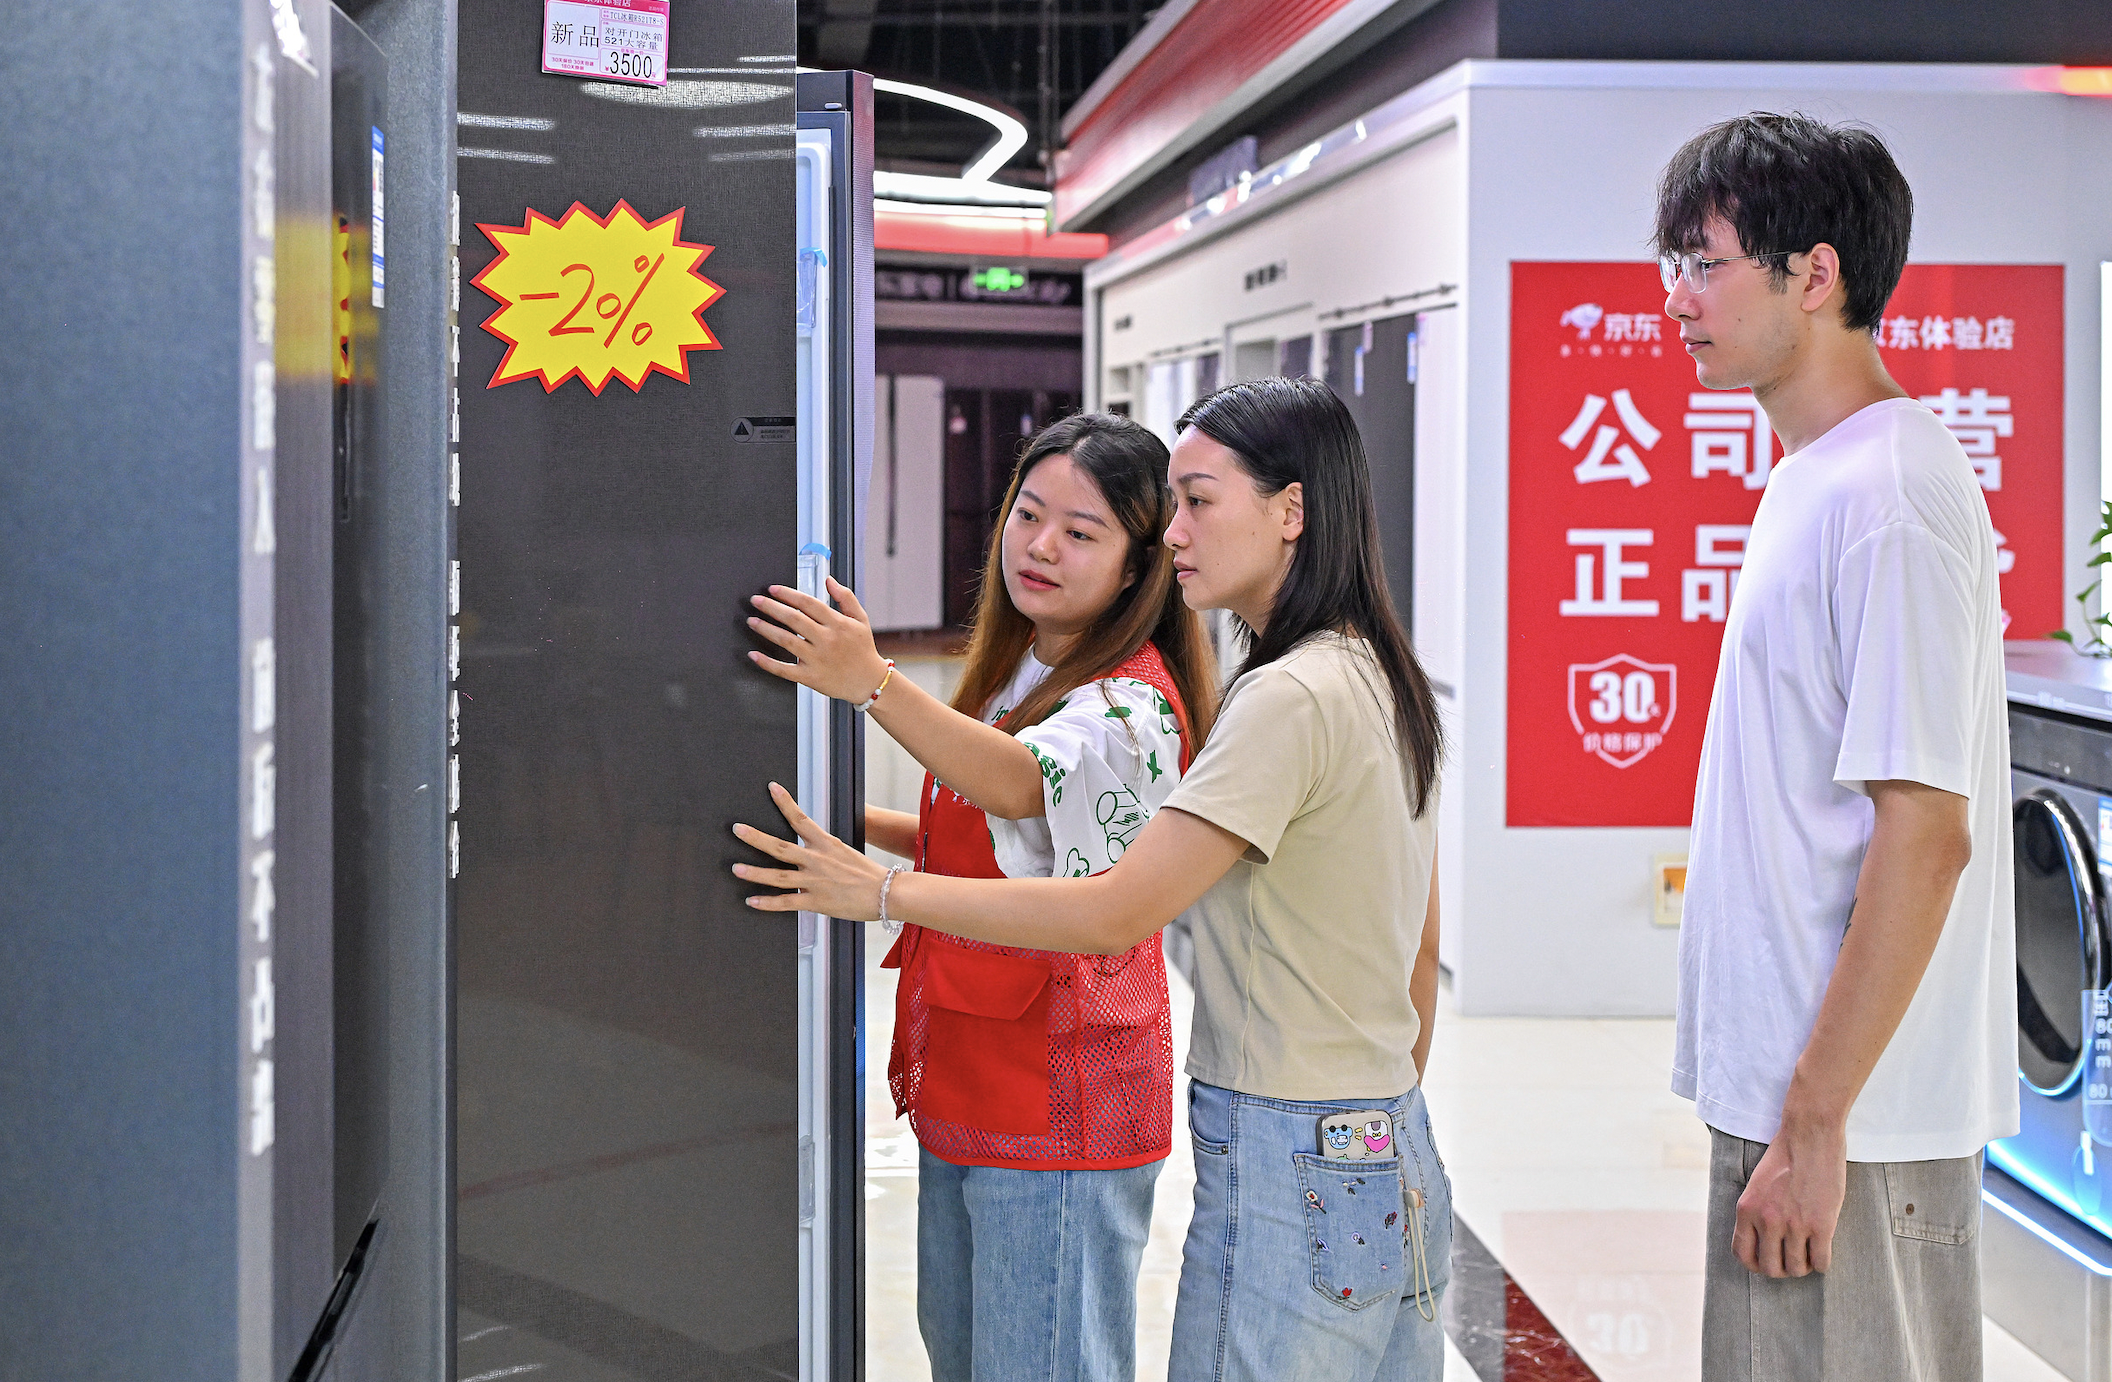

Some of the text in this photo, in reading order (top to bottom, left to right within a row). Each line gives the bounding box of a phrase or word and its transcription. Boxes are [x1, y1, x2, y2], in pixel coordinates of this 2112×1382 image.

[604, 27, 663, 42] 对开门冰箱
[604, 36, 658, 50] 521大容量
[610, 51, 653, 78] 3500
[519, 253, 665, 349] -20%
[1604, 312, 1662, 342] 京东
